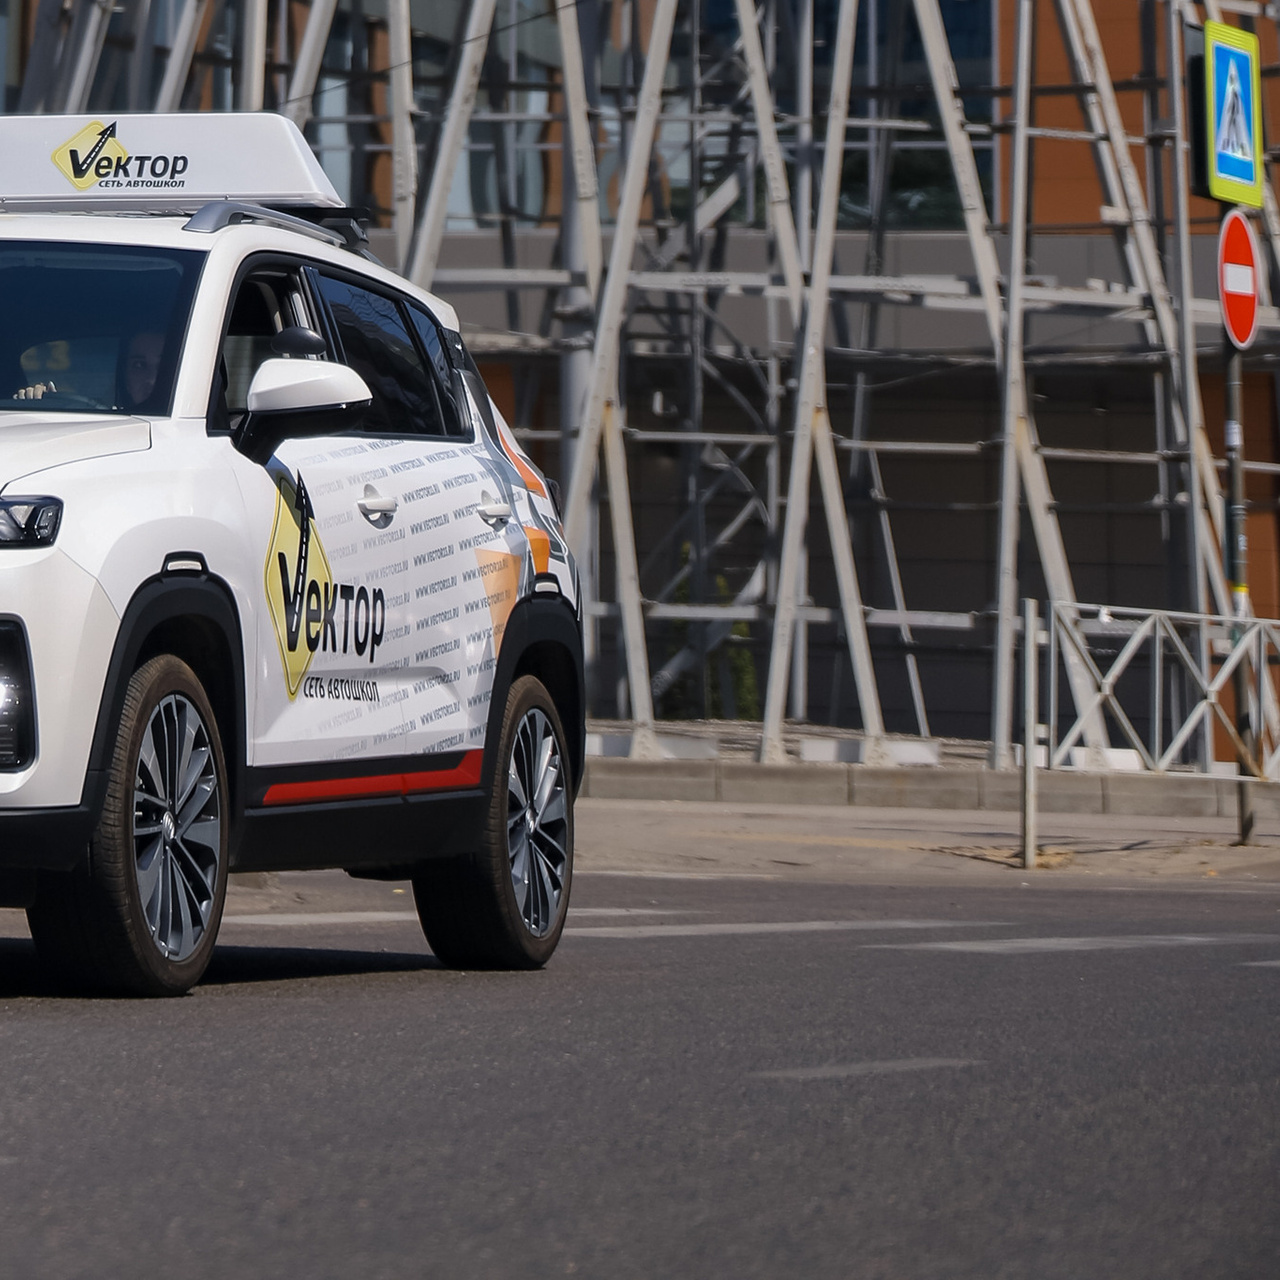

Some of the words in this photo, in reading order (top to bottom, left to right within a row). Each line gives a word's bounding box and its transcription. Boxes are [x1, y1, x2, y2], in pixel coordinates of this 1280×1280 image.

[98, 179, 123, 188] СЕТЬ
[125, 179, 185, 188] АВТОШКОЛ
[303, 676, 326, 699] СЕТЬ
[327, 677, 380, 702] АВТОШКОЛ
